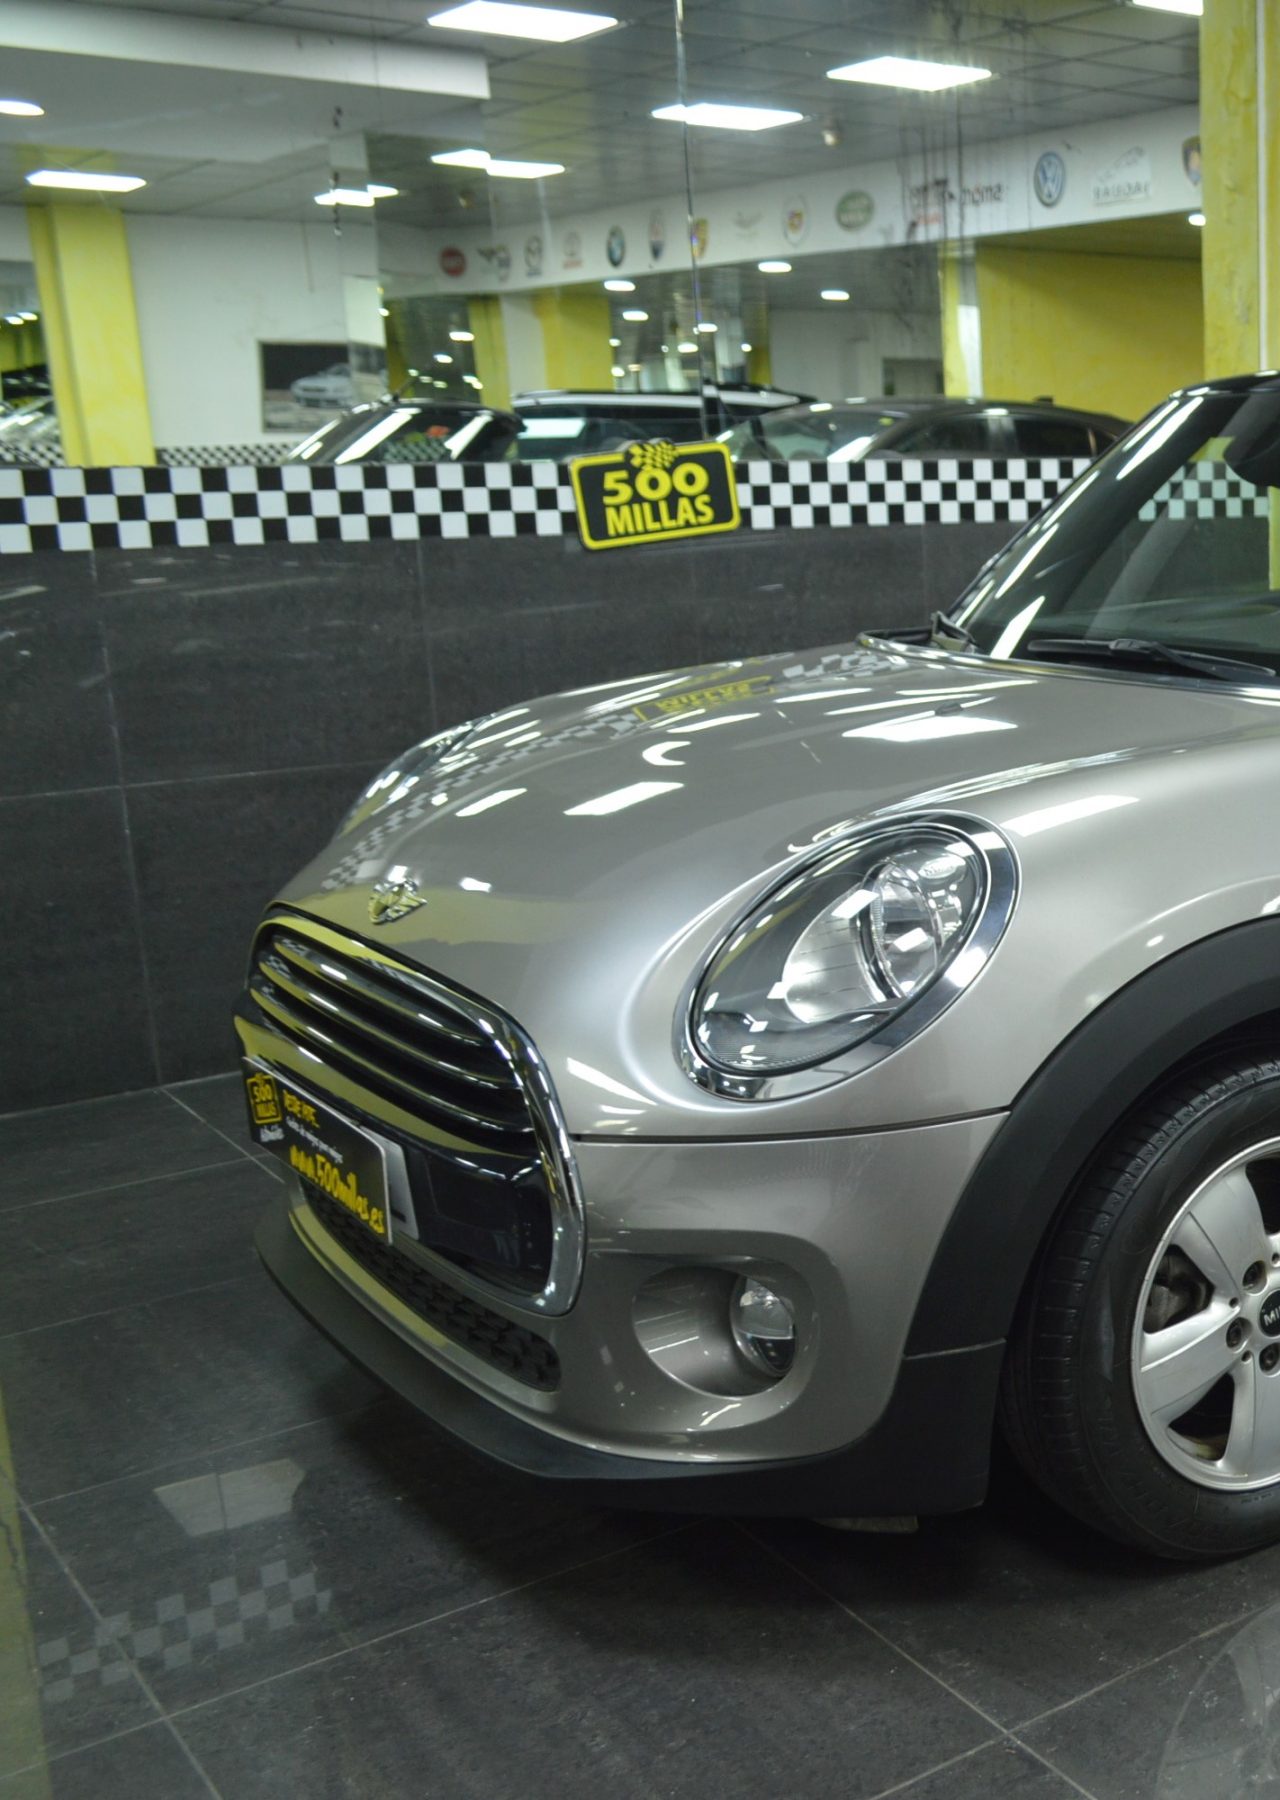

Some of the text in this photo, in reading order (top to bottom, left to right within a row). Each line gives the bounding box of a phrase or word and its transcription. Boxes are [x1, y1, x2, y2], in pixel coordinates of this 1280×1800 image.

[602, 461, 709, 506] 500
[604, 493, 715, 538] MILLAS
[252, 1084, 272, 1102] 500
